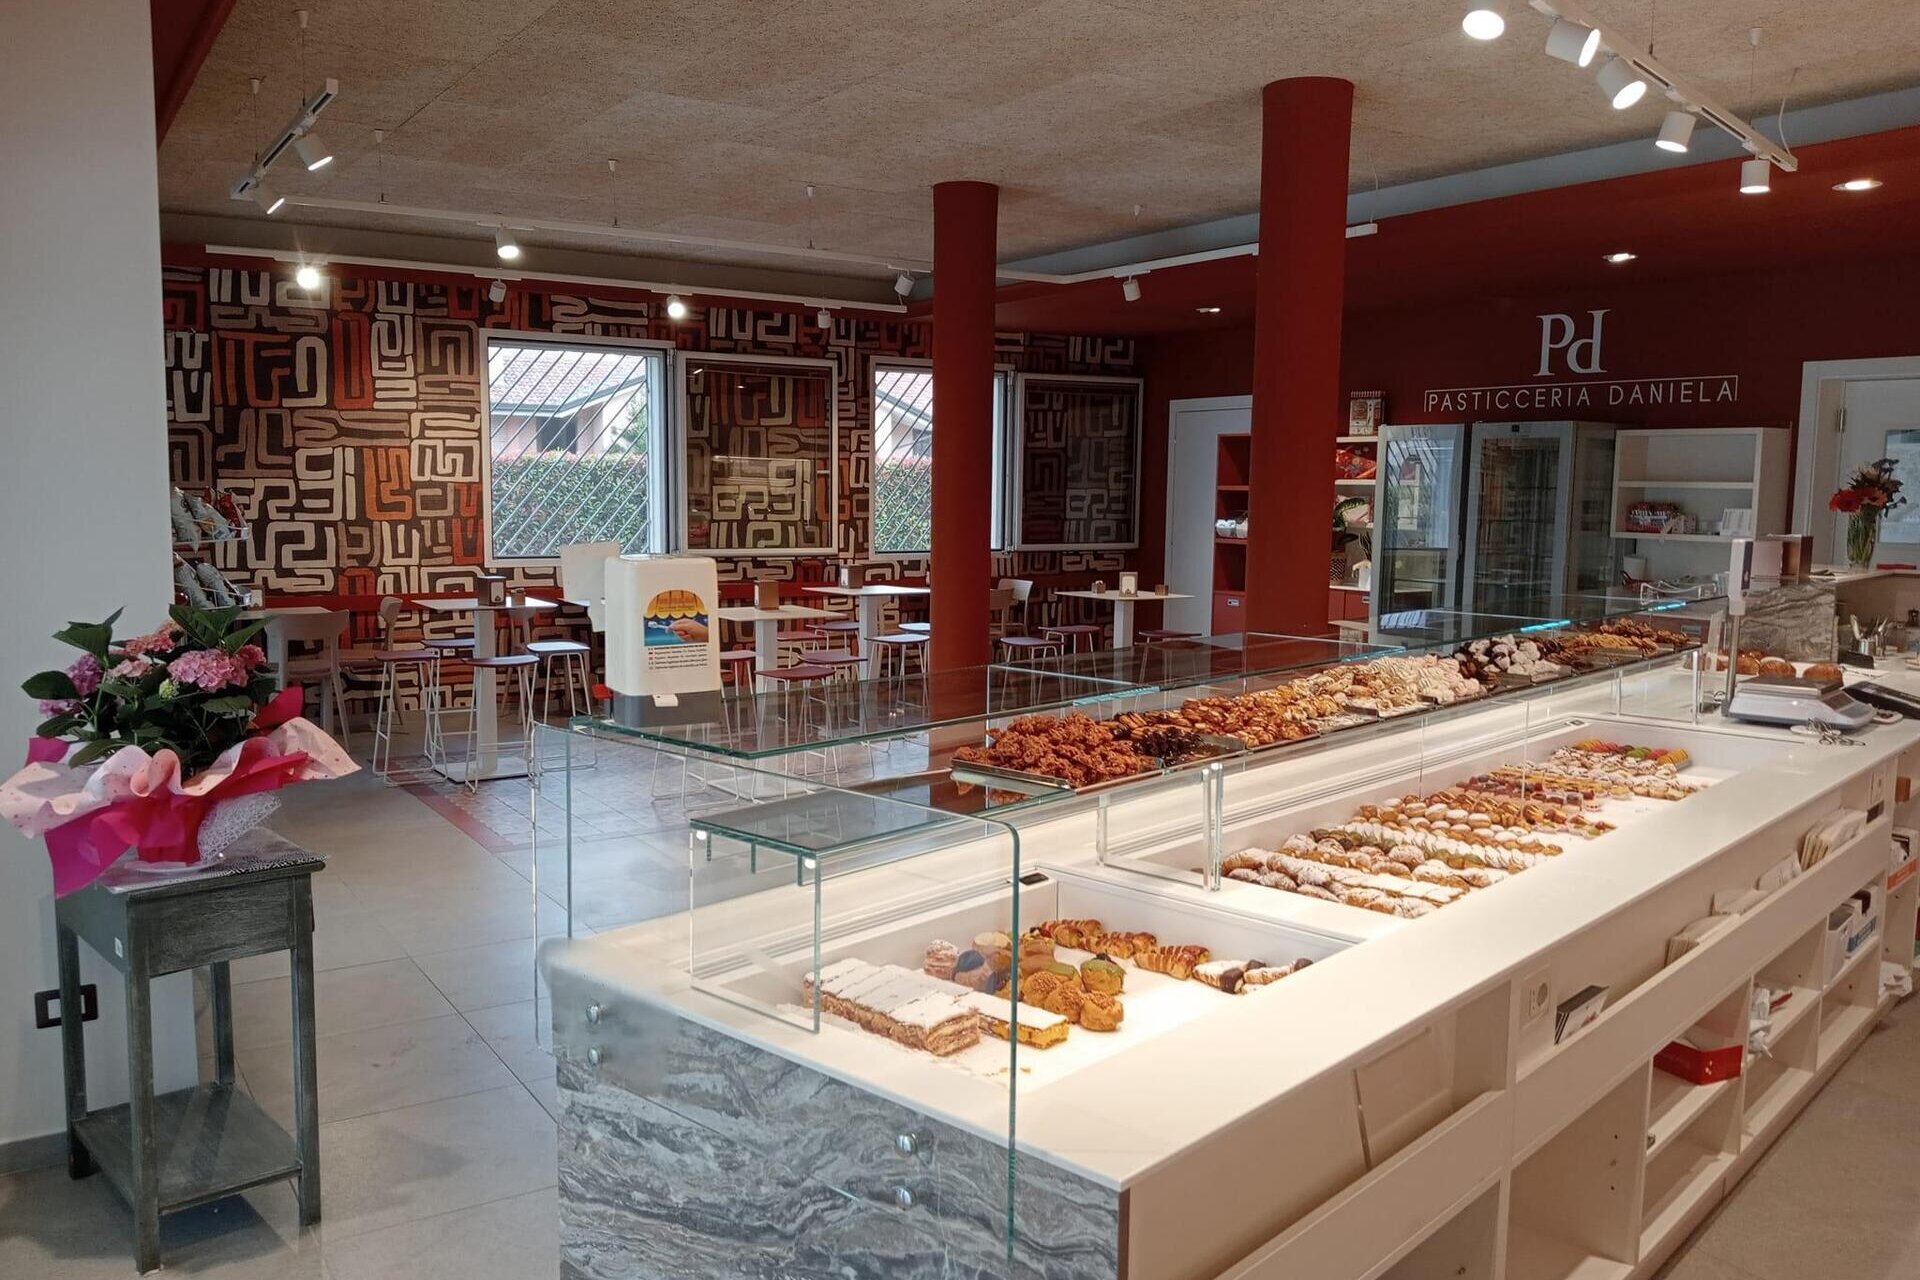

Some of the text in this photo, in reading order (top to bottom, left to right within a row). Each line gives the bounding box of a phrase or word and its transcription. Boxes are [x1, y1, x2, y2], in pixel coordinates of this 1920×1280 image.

[1533, 309, 1611, 377] Pd
[1428, 380, 1733, 412] PASTICCERIA DANIELA
